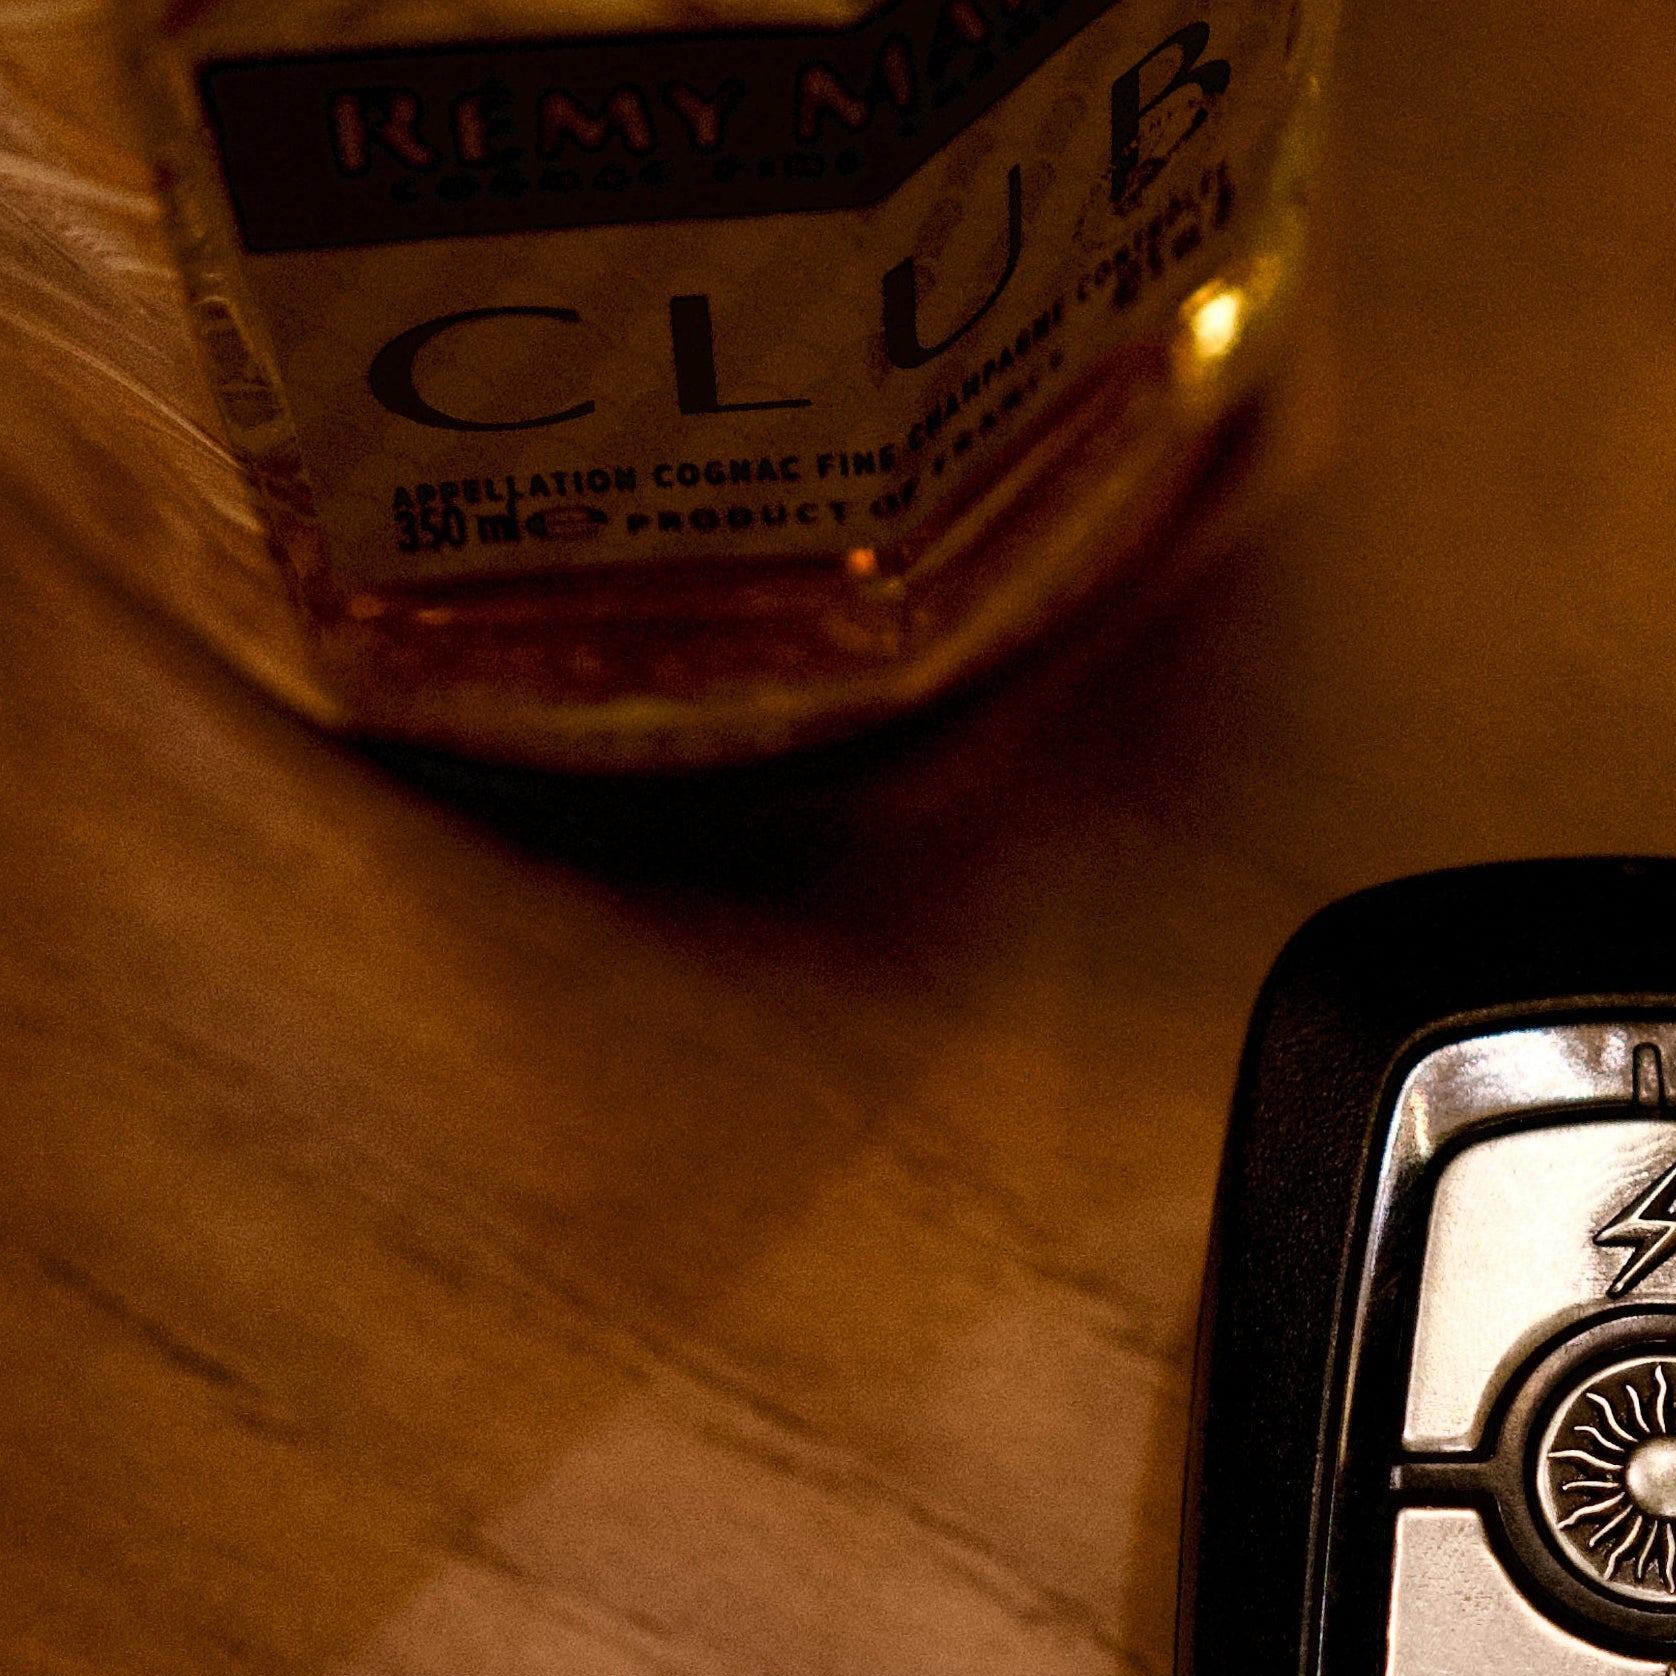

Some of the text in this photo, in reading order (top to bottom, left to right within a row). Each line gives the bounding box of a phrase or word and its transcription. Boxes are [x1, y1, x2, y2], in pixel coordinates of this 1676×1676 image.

[795, 0, 1022, 143] MA
[368, 21, 1231, 432] CLUB
[393, 464, 637, 509] APPELLATION
[653, 456, 800, 489] COGNAC
[817, 444, 895, 479] FINE
[395, 505, 466, 551] 350
[627, 500, 847, 535] PRODUCT
